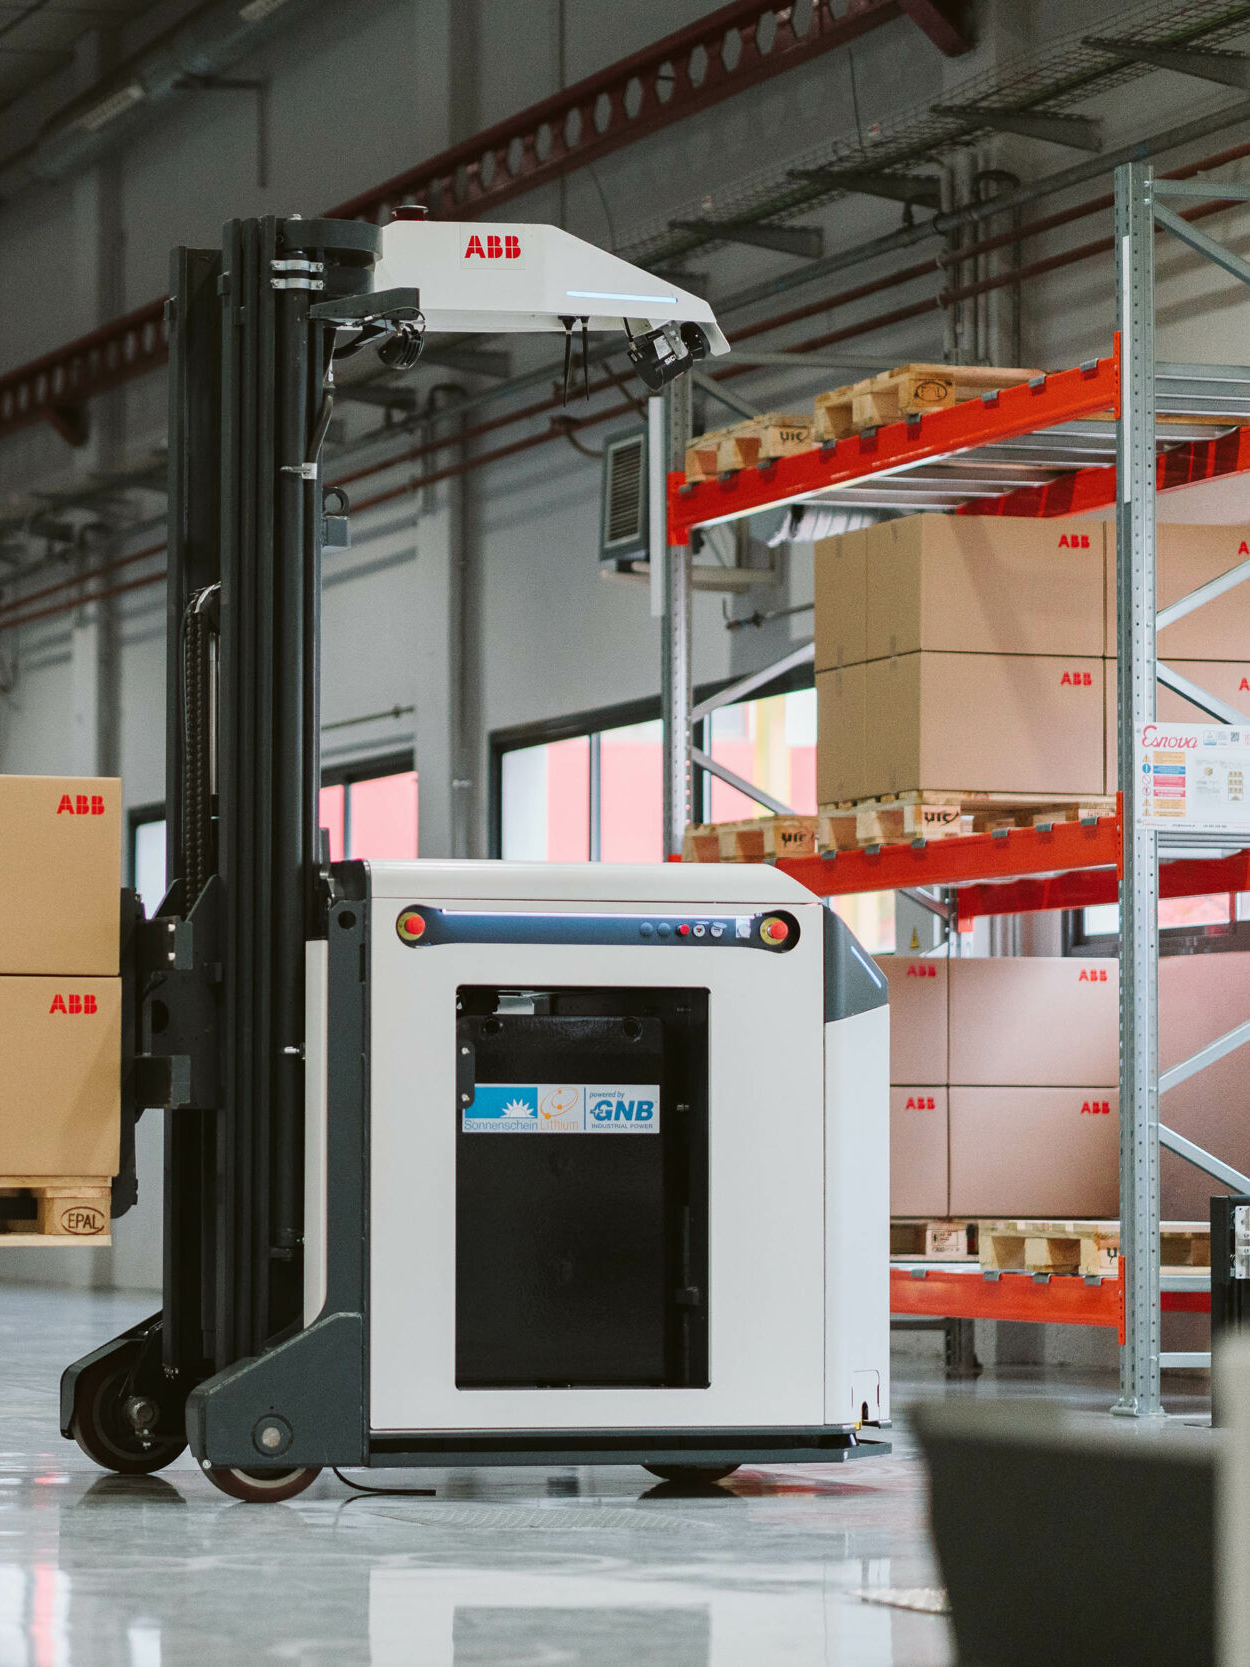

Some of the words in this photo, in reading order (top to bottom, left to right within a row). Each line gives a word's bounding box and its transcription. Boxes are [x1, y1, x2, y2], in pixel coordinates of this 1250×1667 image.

[465, 235, 521, 259] ABB
[664, 354, 677, 365] SIC
[1058, 534, 1090, 549] ABB
[1061, 672, 1092, 686] ABB
[57, 794, 105, 815] ABB
[907, 964, 937, 978] ABB
[1078, 969, 1108, 982] ABB
[49, 994, 98, 1015] ABB
[589, 1091, 615, 1099] powered
[616, 1091, 625, 1099] by
[591, 1099, 655, 1122] GNB
[906, 1097, 936, 1111] ABB
[1081, 1101, 1110, 1115] ABB
[464, 1119, 538, 1131] Sonnenschein
[540, 1119, 579, 1131] Lithium
[68, 1213, 100, 1230] EPAL
